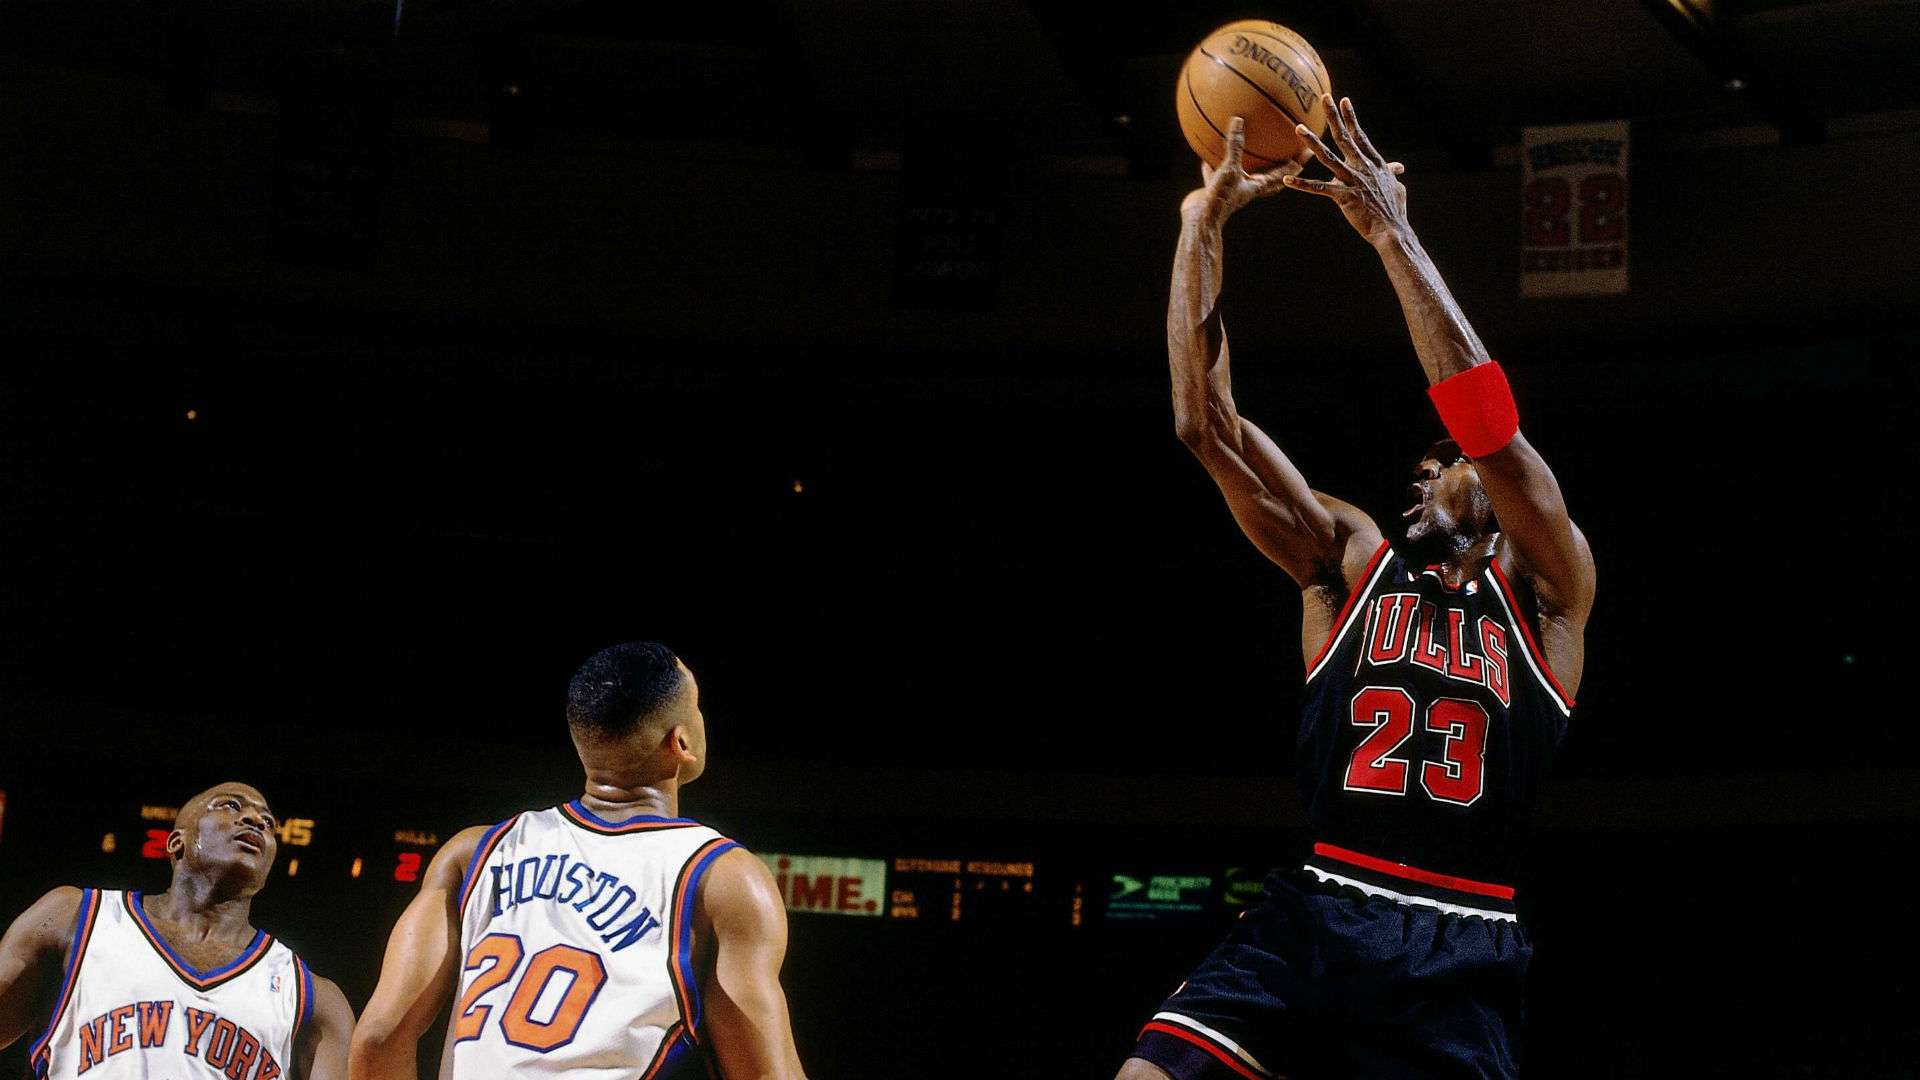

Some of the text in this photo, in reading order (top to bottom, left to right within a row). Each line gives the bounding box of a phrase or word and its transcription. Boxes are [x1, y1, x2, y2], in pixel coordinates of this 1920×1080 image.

[1229, 35, 1319, 113] SPALDING
[1354, 593, 1510, 708] ULLS
[1344, 686, 1489, 806] 23
[490, 854, 661, 952] HOUSTON
[78, 1000, 281, 1080] NEW YORK
[454, 932, 608, 1053] 20
